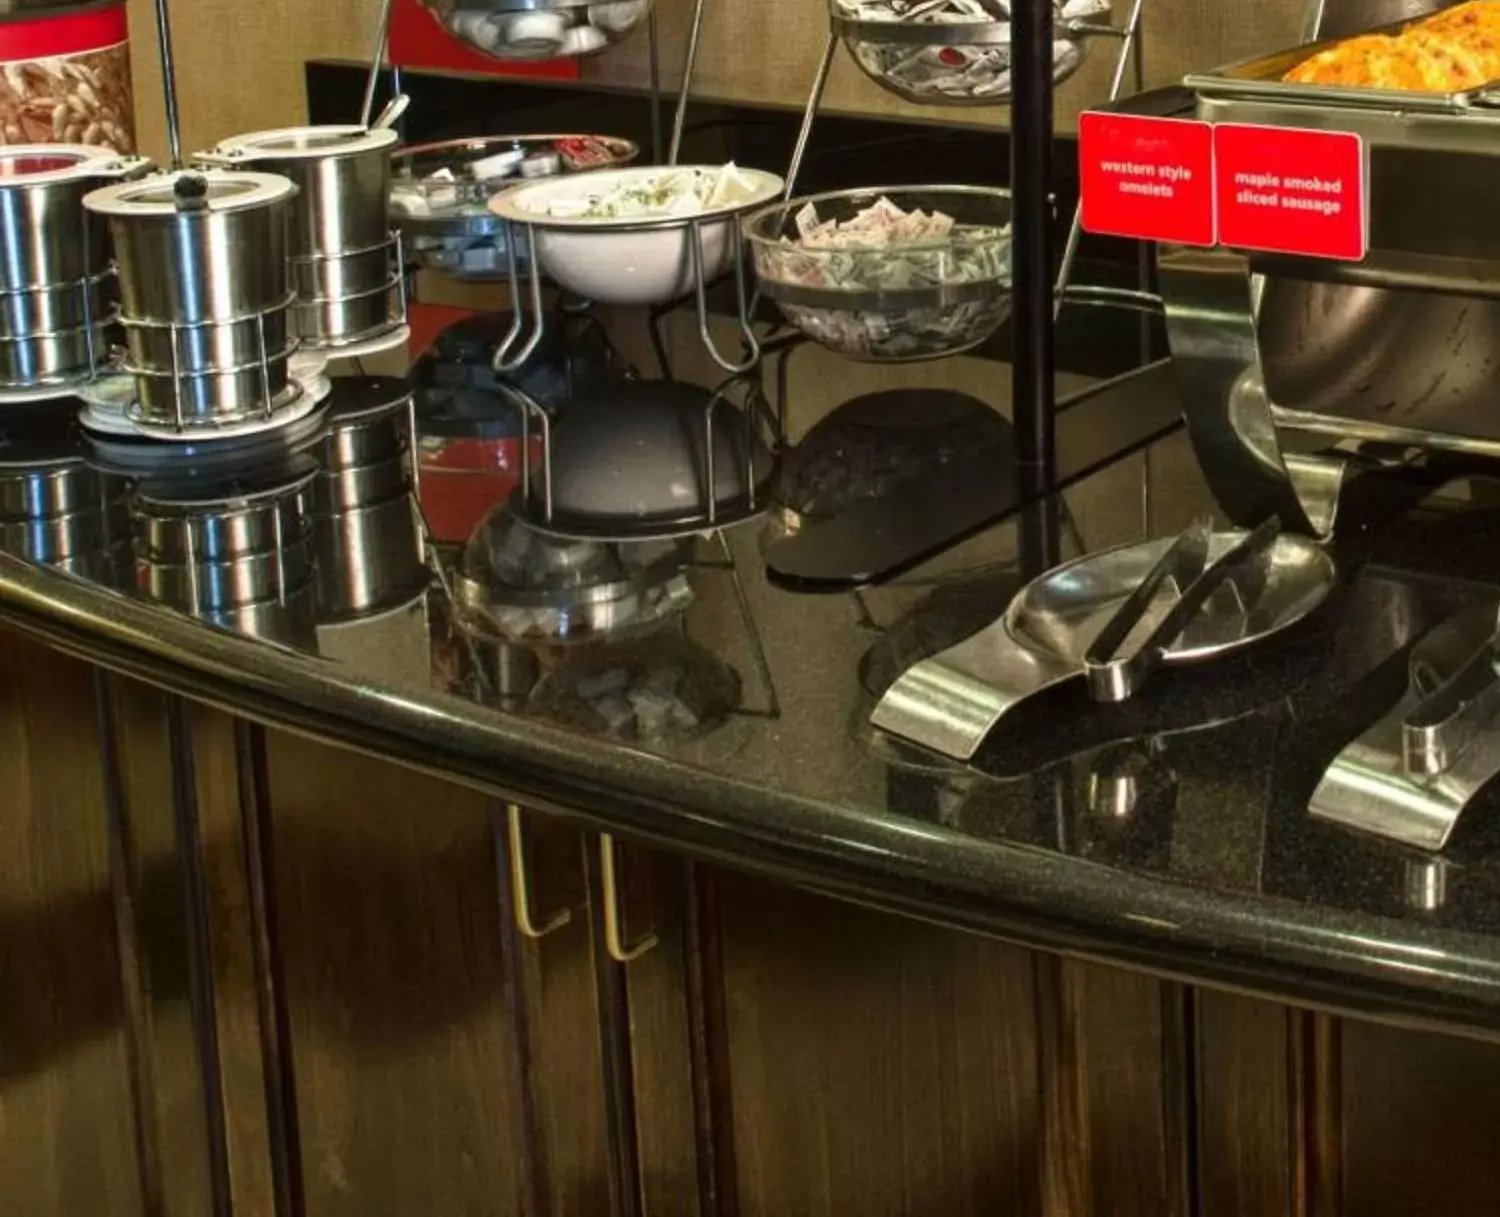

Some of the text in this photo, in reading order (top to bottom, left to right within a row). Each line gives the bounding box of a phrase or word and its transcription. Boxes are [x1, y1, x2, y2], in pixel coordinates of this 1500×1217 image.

[1100, 160, 1192, 182] western style
[1119, 179, 1175, 198] omelets
[1234, 172, 1342, 194] maple smoked
[1236, 189, 1342, 216] sliced sausage
